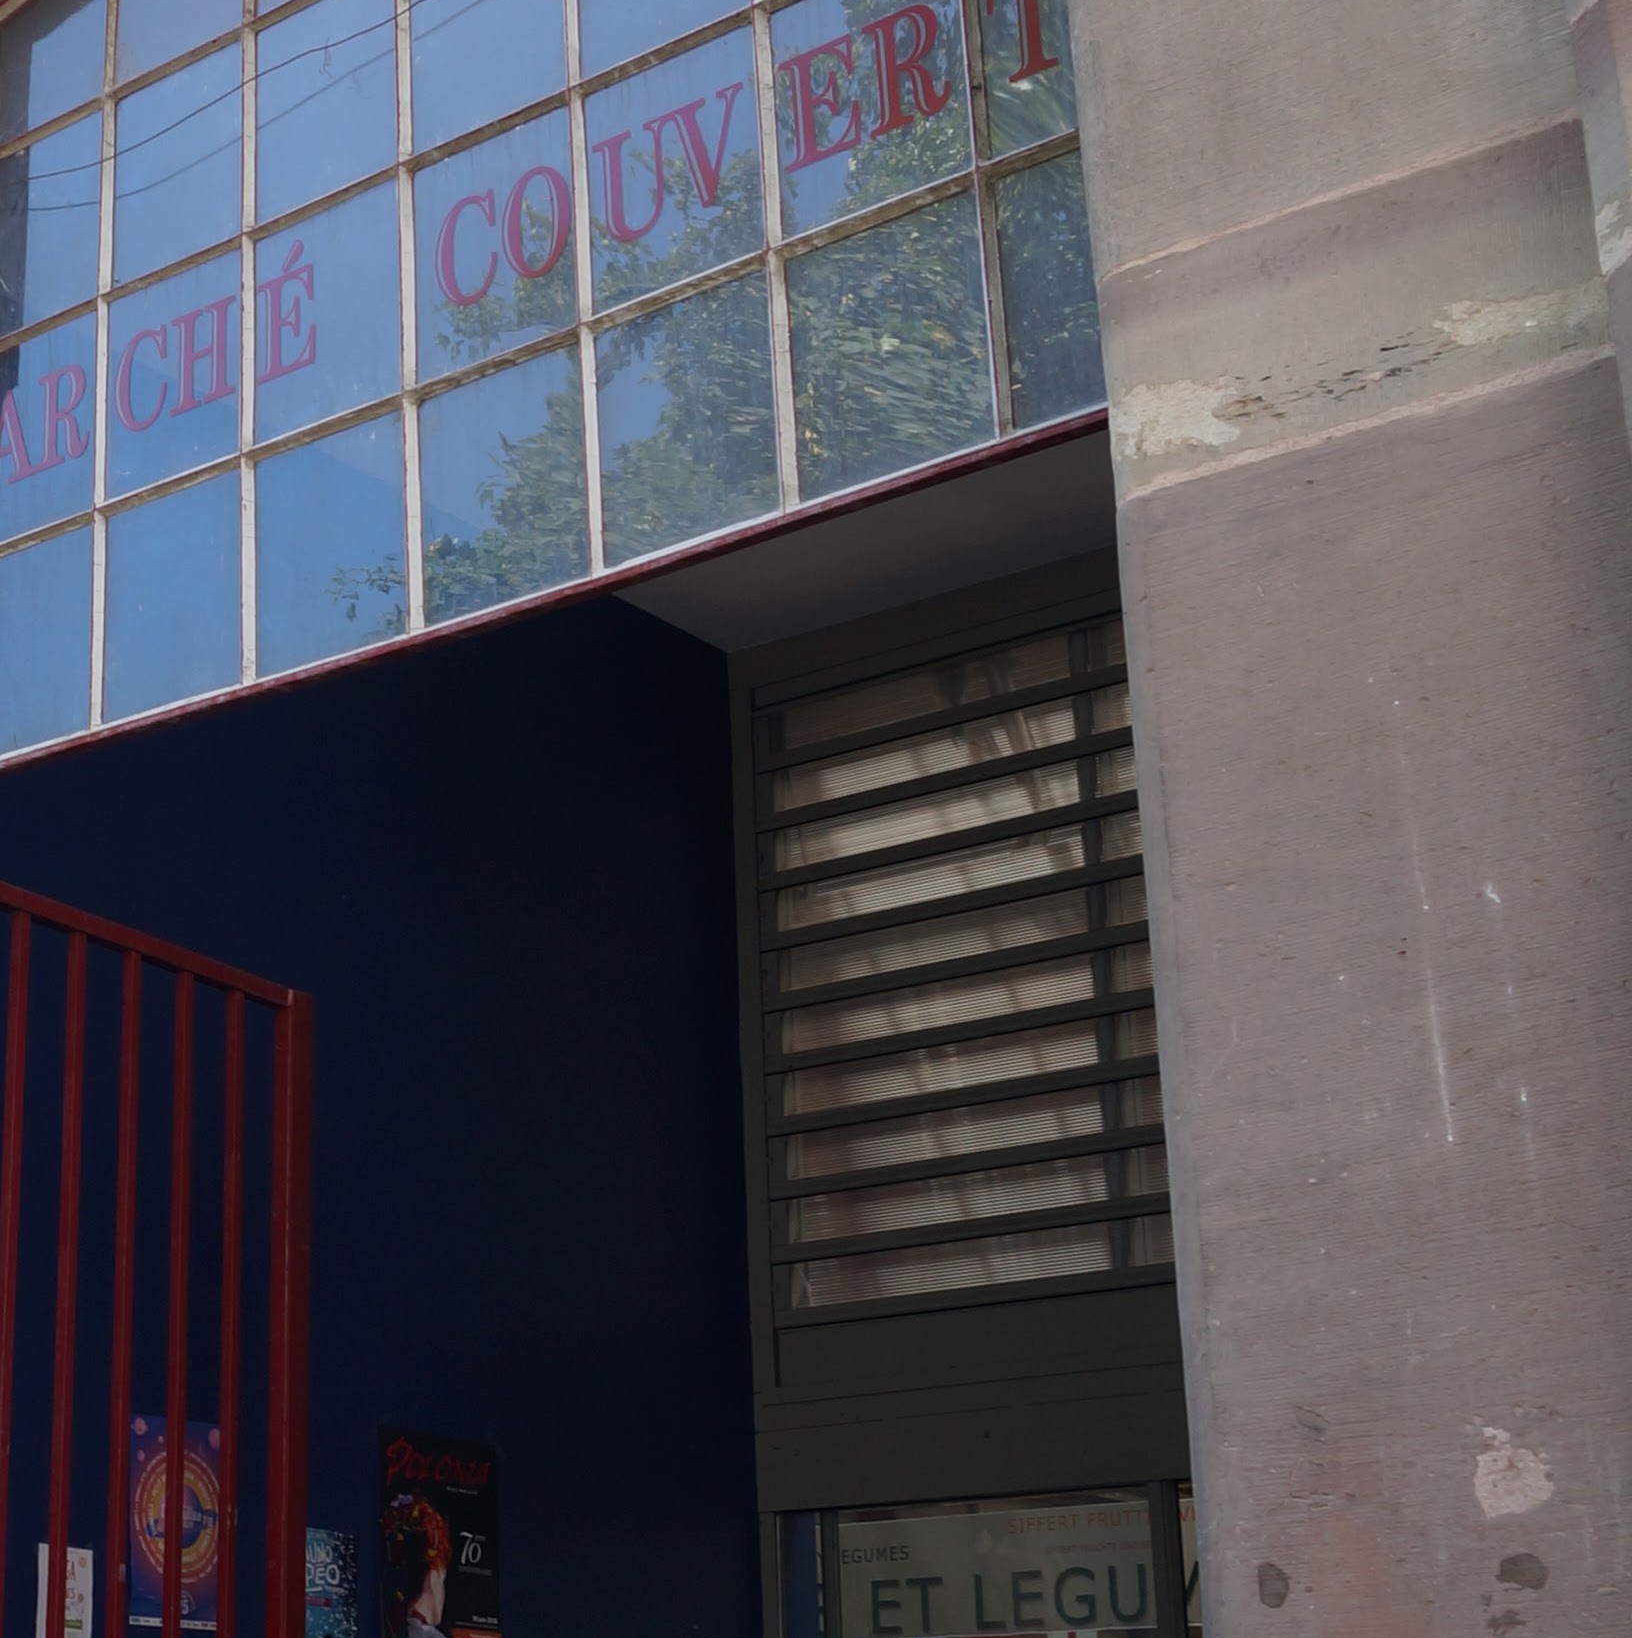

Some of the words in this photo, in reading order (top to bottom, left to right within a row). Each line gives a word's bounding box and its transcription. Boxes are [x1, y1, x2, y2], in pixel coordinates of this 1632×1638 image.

[1007, 1514, 1079, 1535] SIFFERT
[459, 1531, 483, 1565] 70
[871, 1576, 943, 1635] ET
